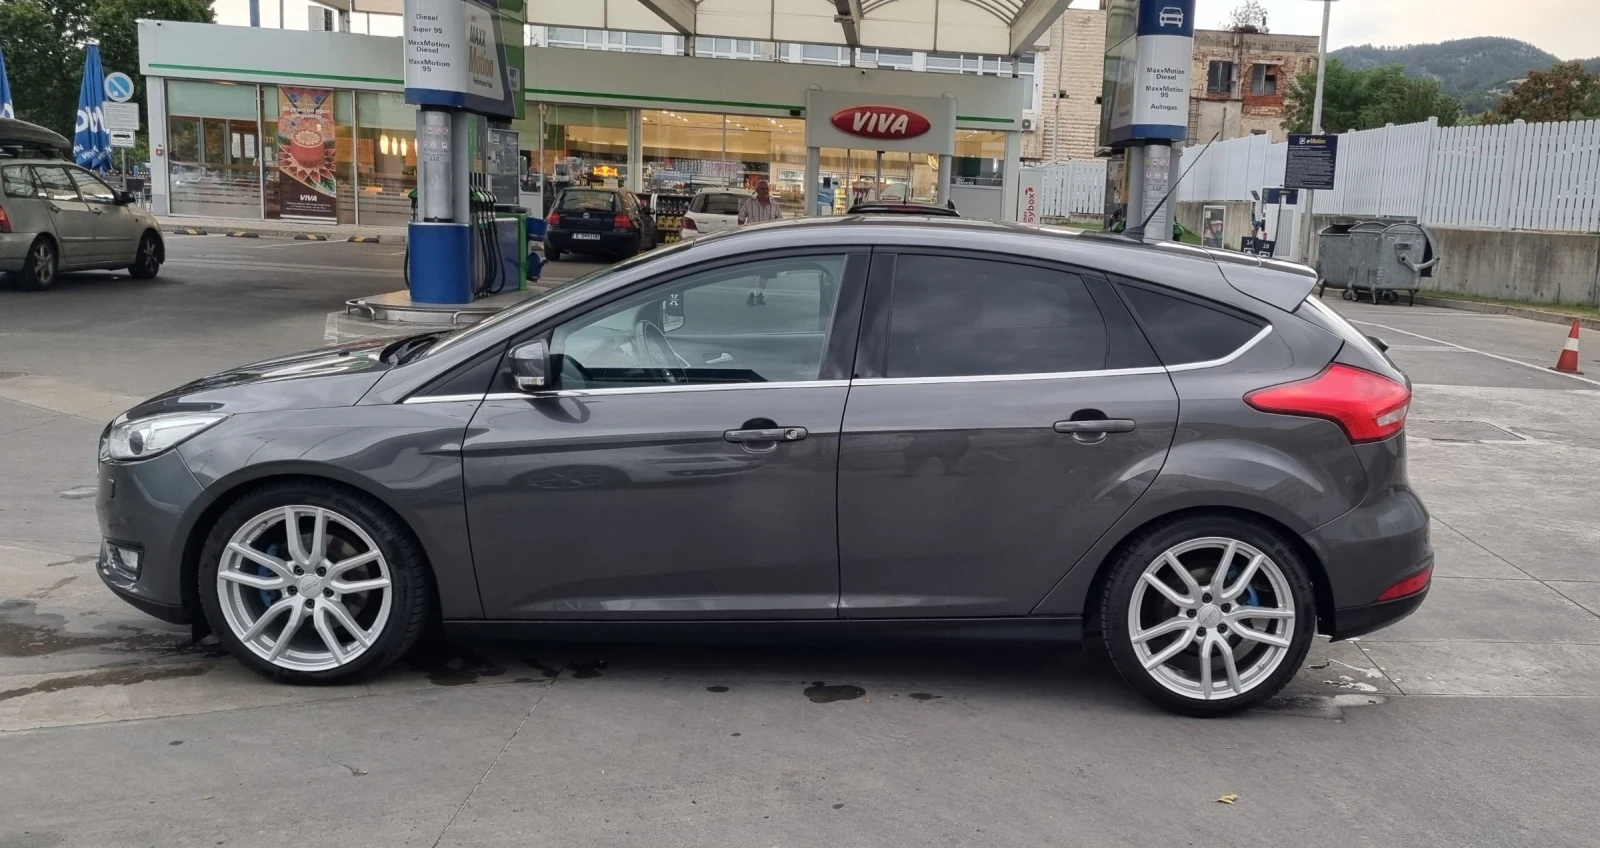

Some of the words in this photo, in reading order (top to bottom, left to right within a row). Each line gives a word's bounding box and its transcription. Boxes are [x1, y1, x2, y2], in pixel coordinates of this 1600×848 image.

[470, 25, 486, 47] MAXX
[408, 40, 450, 48] MaxxMotion
[408, 59, 450, 67] MaxxMotion
[468, 46, 494, 78] Motion
[1146, 67, 1184, 76] MaxxMotion
[1150, 104, 1178, 112] Autogas
[852, 111, 908, 134] VIVA
[1026, 194, 1035, 222] sybox
